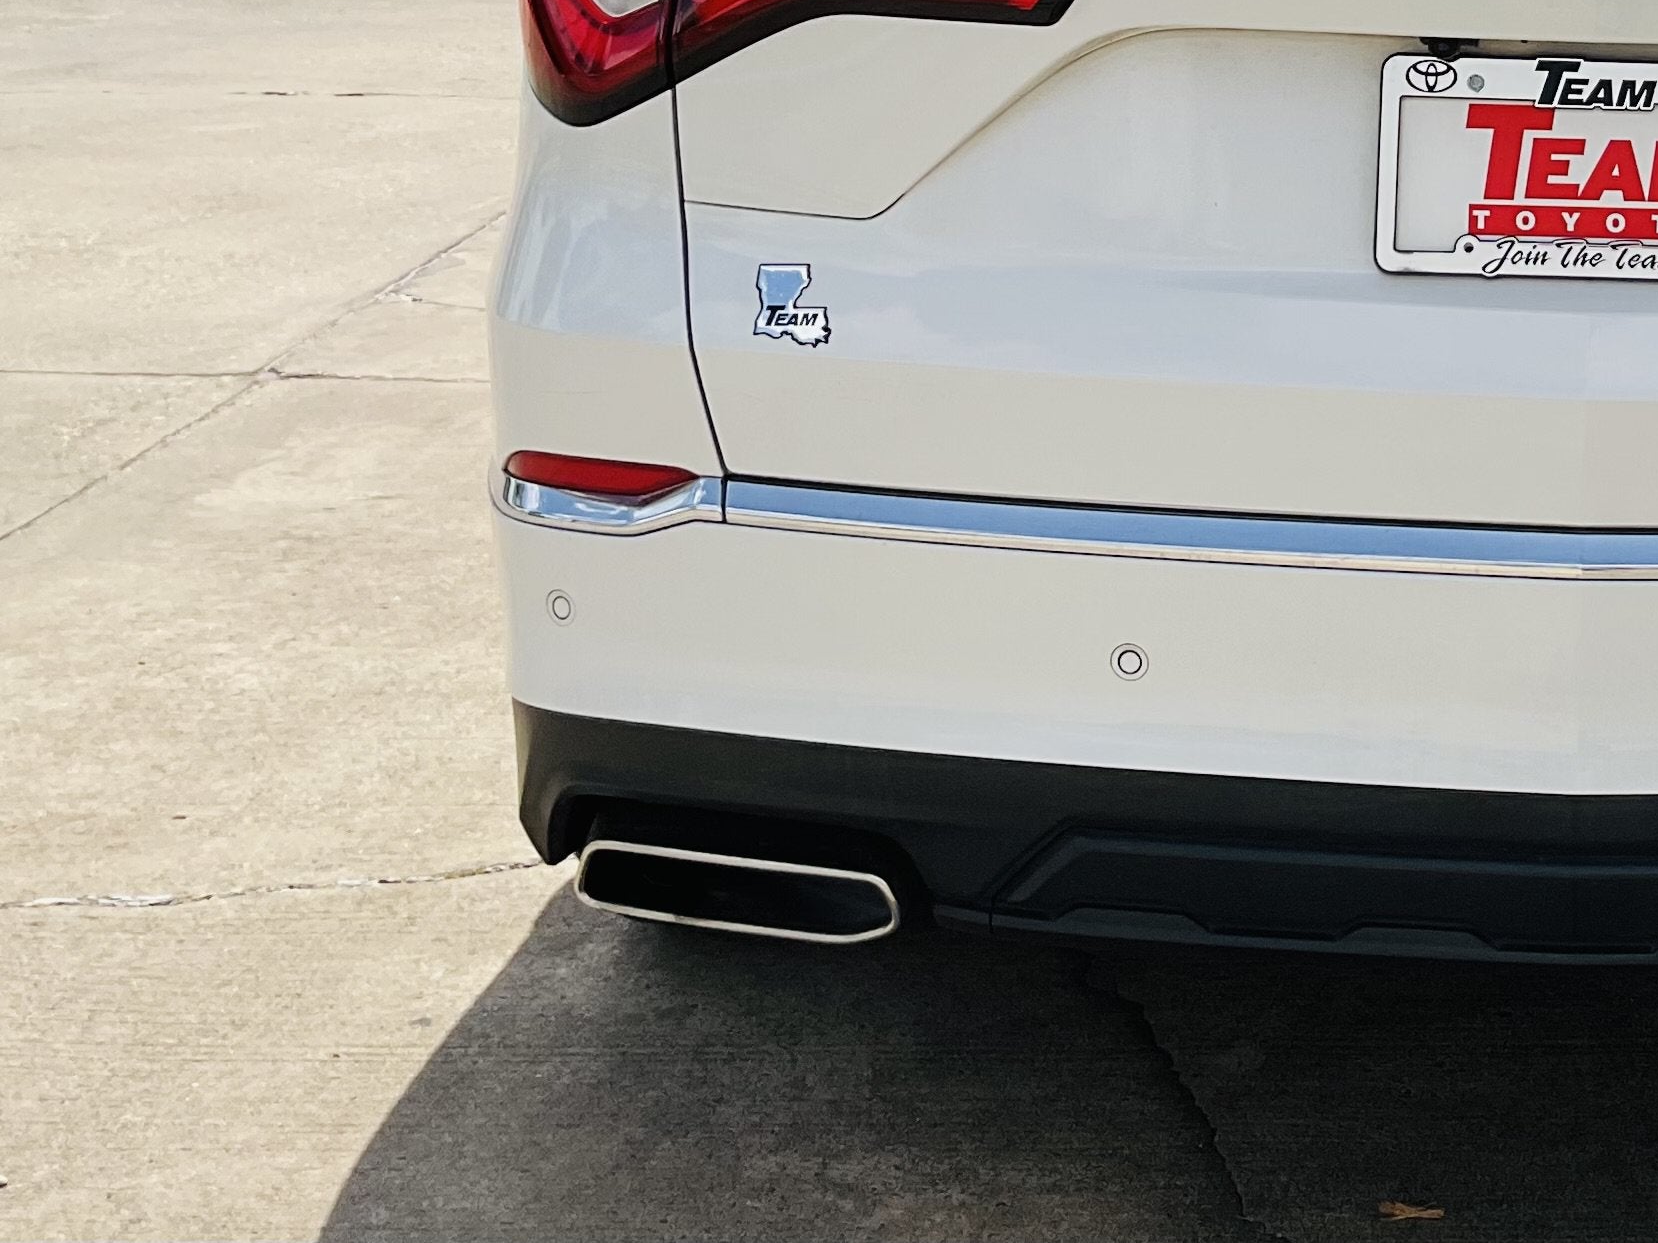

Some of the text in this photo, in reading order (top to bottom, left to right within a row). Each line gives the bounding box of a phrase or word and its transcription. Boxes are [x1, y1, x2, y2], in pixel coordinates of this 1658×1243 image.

[1535, 59, 1657, 108] TEAM
[1482, 240, 1551, 274] Join
[1555, 240, 1606, 268] The
[765, 305, 819, 326] TEAM
